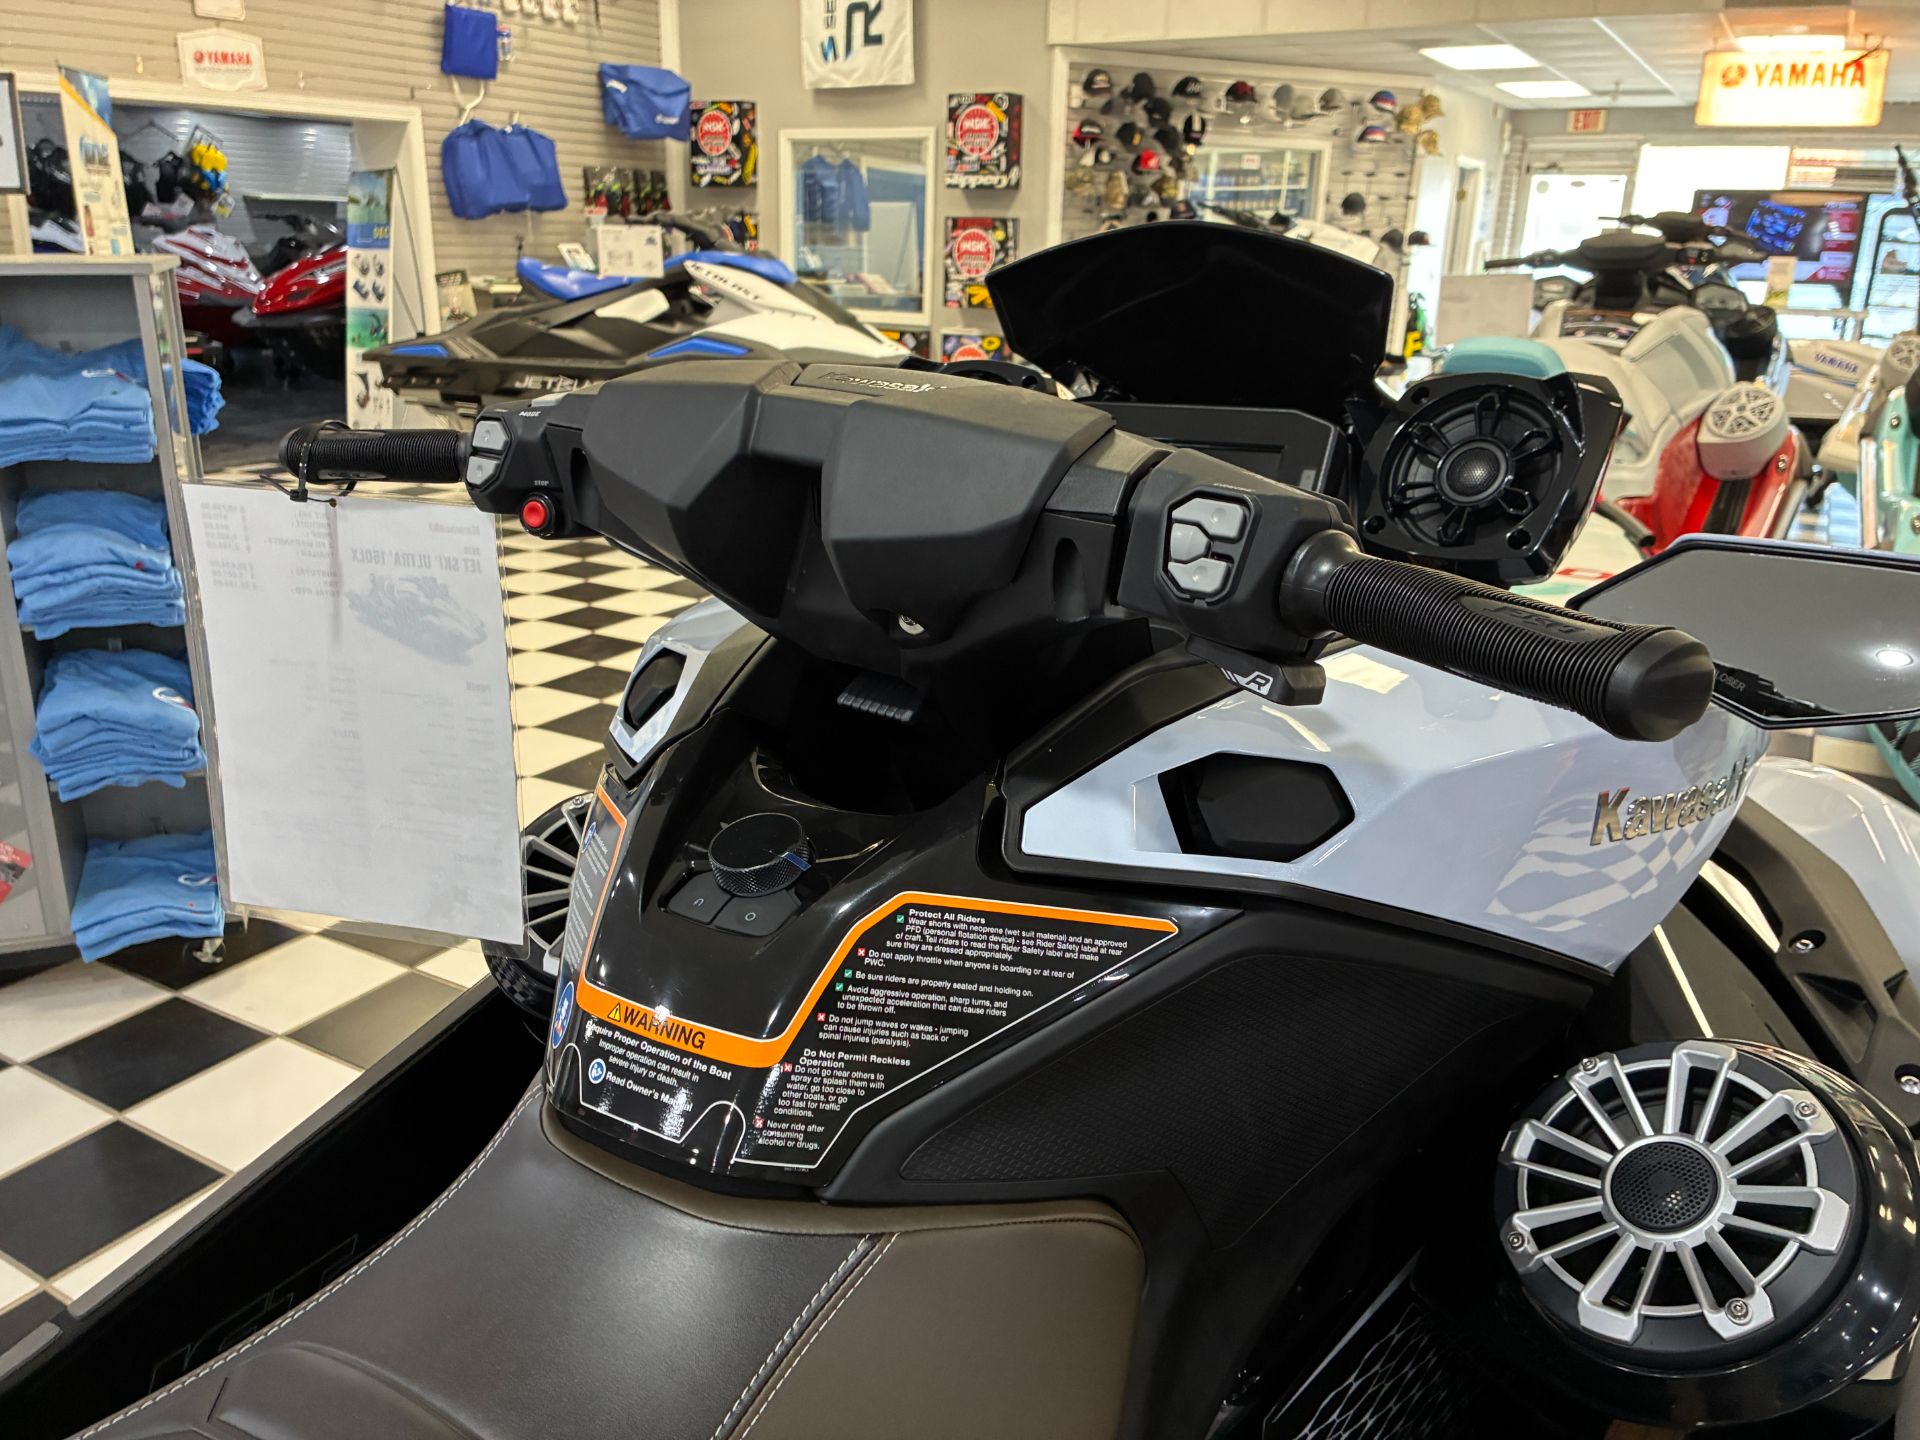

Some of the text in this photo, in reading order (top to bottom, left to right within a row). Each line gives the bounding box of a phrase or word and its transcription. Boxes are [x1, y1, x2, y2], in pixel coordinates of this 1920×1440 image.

[207, 50, 252, 65] YAMAHA
[1755, 62, 1866, 88] YAMAHA
[1573, 111, 1602, 132] EXIT
[818, 372, 947, 393] Kawasaki
[909, 908, 986, 924] Protect All Riders
[906, 924, 920, 934] PFD
[922, 928, 956, 938] (personal
[958, 931, 987, 941] flotation
[989, 934, 1014, 944] device)
[1036, 939, 1056, 949] Rider
[1057, 942, 1079, 952] Safety
[1081, 944, 1098, 954] label
[908, 918, 927, 926] Wear
[928, 919, 951, 929] shorts
[953, 920, 968, 930] with
[970, 924, 1003, 935] neoprene
[1004, 928, 1020, 936] (wet
[1022, 930, 1034, 938] suit
[1036, 932, 1067, 942] material)
[1068, 935, 1082, 943] and
[1094, 939, 1128, 948] approved
[886, 940, 902, 948] sure
[904, 941, 920, 952] they
[934, 944, 963, 954] dressed
[965, 948, 1013, 962] appropriately.
[896, 932, 904, 940] of
[904, 932, 924, 942] craft.
[925, 934, 937, 944] Tell
[938, 937, 960, 946] riders
[970, 941, 986, 949] read
[988, 942, 999, 950] the
[1001, 944, 1020, 952] Rider
[1022, 946, 1044, 956] Safety
[1046, 948, 1063, 958] label
[1064, 951, 1078, 960] and
[1080, 952, 1100, 962] make
[864, 958, 886, 967] PWC.
[868, 950, 880, 958] Do
[894, 954, 914, 963] apply
[916, 954, 942, 964] throttle
[944, 958, 962, 966] when
[964, 961, 990, 970] anyone
[1000, 964, 1032, 976] boarding
[1042, 968, 1050, 976] at
[1052, 970, 1066, 978] rear
[1066, 971, 1074, 979] of
[855, 971, 866, 980] Be
[868, 973, 884, 982] sure
[885, 974, 906, 984] riders
[921, 978, 951, 990] properly
[952, 982, 978, 991] seated
[978, 984, 992, 992] and
[994, 986, 1020, 997] holding
[842, 994, 1006, 1016] unexpected acceleration that can cause riders
[847, 984, 868, 994] Avoid
[870, 988, 910, 999] aggressive
[912, 991, 948, 1002] operation,
[950, 996, 970, 1006] sharp
[972, 998, 992, 1007] turns,
[624, 1006, 706, 1050] WARNING
[828, 1014, 840, 1022] Do
[841, 1016, 854, 1024] not
[854, 1016, 874, 1027] jump
[875, 1020, 898, 1029] waves
[910, 1022, 932, 1032] wakes
[939, 1025, 968, 1037] jumping
[839, 1026, 862, 1034] cause
[863, 1028, 890, 1036] injuries
[892, 1030, 908, 1038] such
[910, 1032, 920, 1040] as
[921, 1032, 939, 1041] back
[940, 1034, 949, 1042] or
[586, 1020, 732, 1080] Require Proper Operation of the Boat
[598, 1038, 699, 1082] Improper operation can result in
[804, 1048, 910, 1066] Do Not Permit Reckless
[608, 1056, 678, 1087] severe injury or death.
[794, 1065, 806, 1073] Do
[808, 1066, 820, 1074] not
[851, 1070, 874, 1080] others
[876, 1072, 884, 1080] to
[800, 1057, 844, 1068] Operation
[606, 1071, 626, 1086] Read
[626, 1080, 659, 1100] Owner's
[790, 1074, 812, 1084] spray
[822, 1076, 847, 1086] splash
[849, 1078, 868, 1088] them
[870, 1081, 884, 1089] with
[762, 1129, 804, 1140] consuming
[766, 1120, 824, 1132] Never ride after
[758, 1138, 820, 1150] alcohol or drugs.
